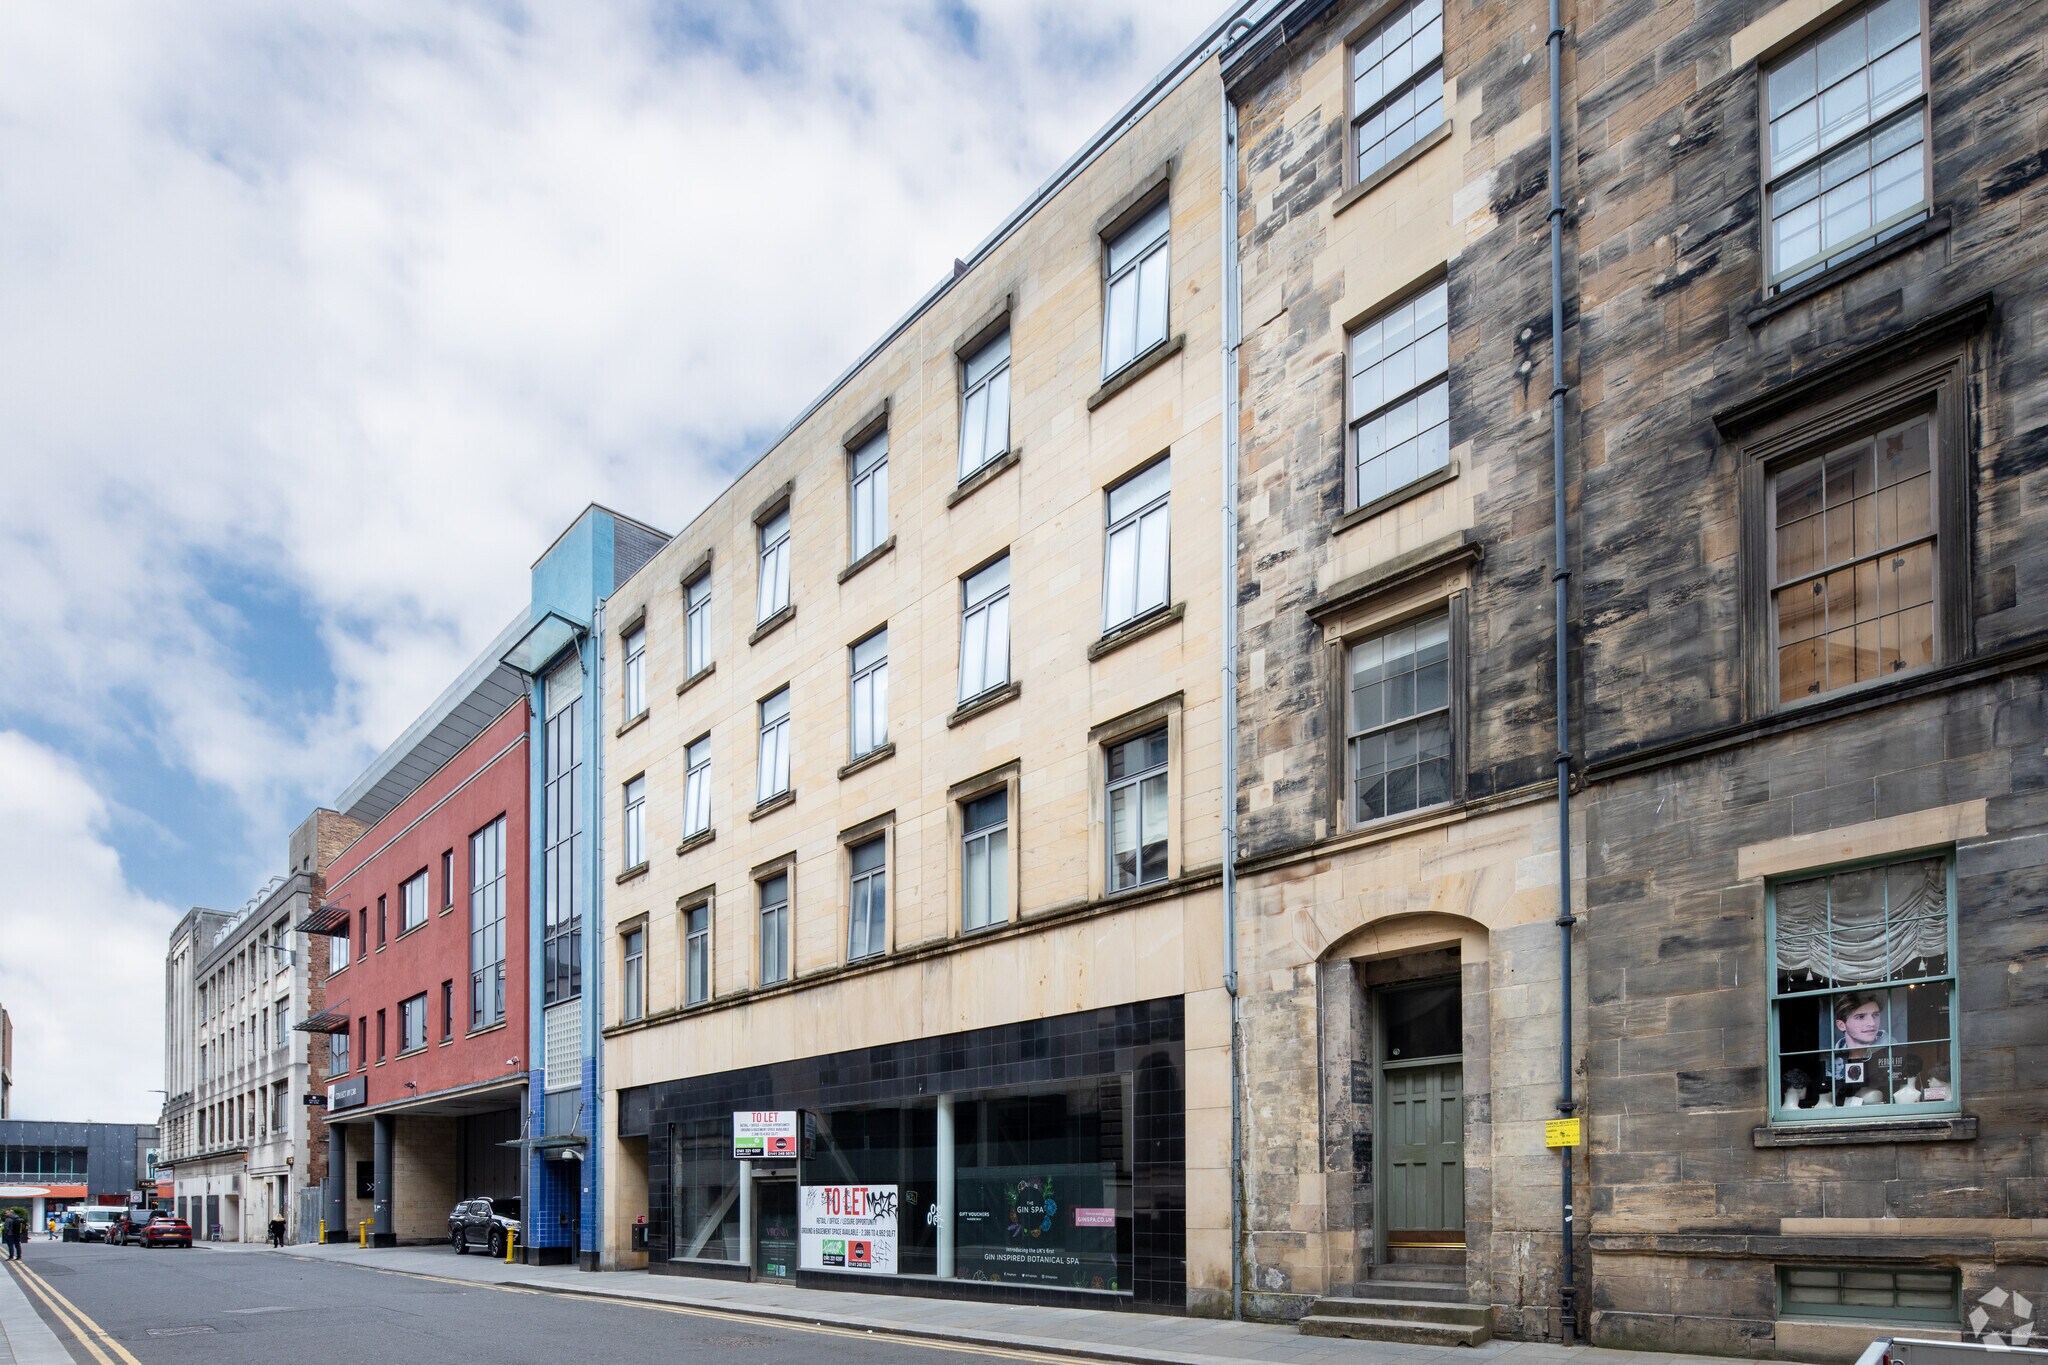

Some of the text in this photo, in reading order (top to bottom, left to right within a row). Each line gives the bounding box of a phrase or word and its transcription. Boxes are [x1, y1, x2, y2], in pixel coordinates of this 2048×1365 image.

[752, 1112, 778, 1122] TO LET
[825, 1188, 840, 1215] TO
[845, 1188, 868, 1215] LET
[1028, 1256, 1064, 1264] BOTANICAL
